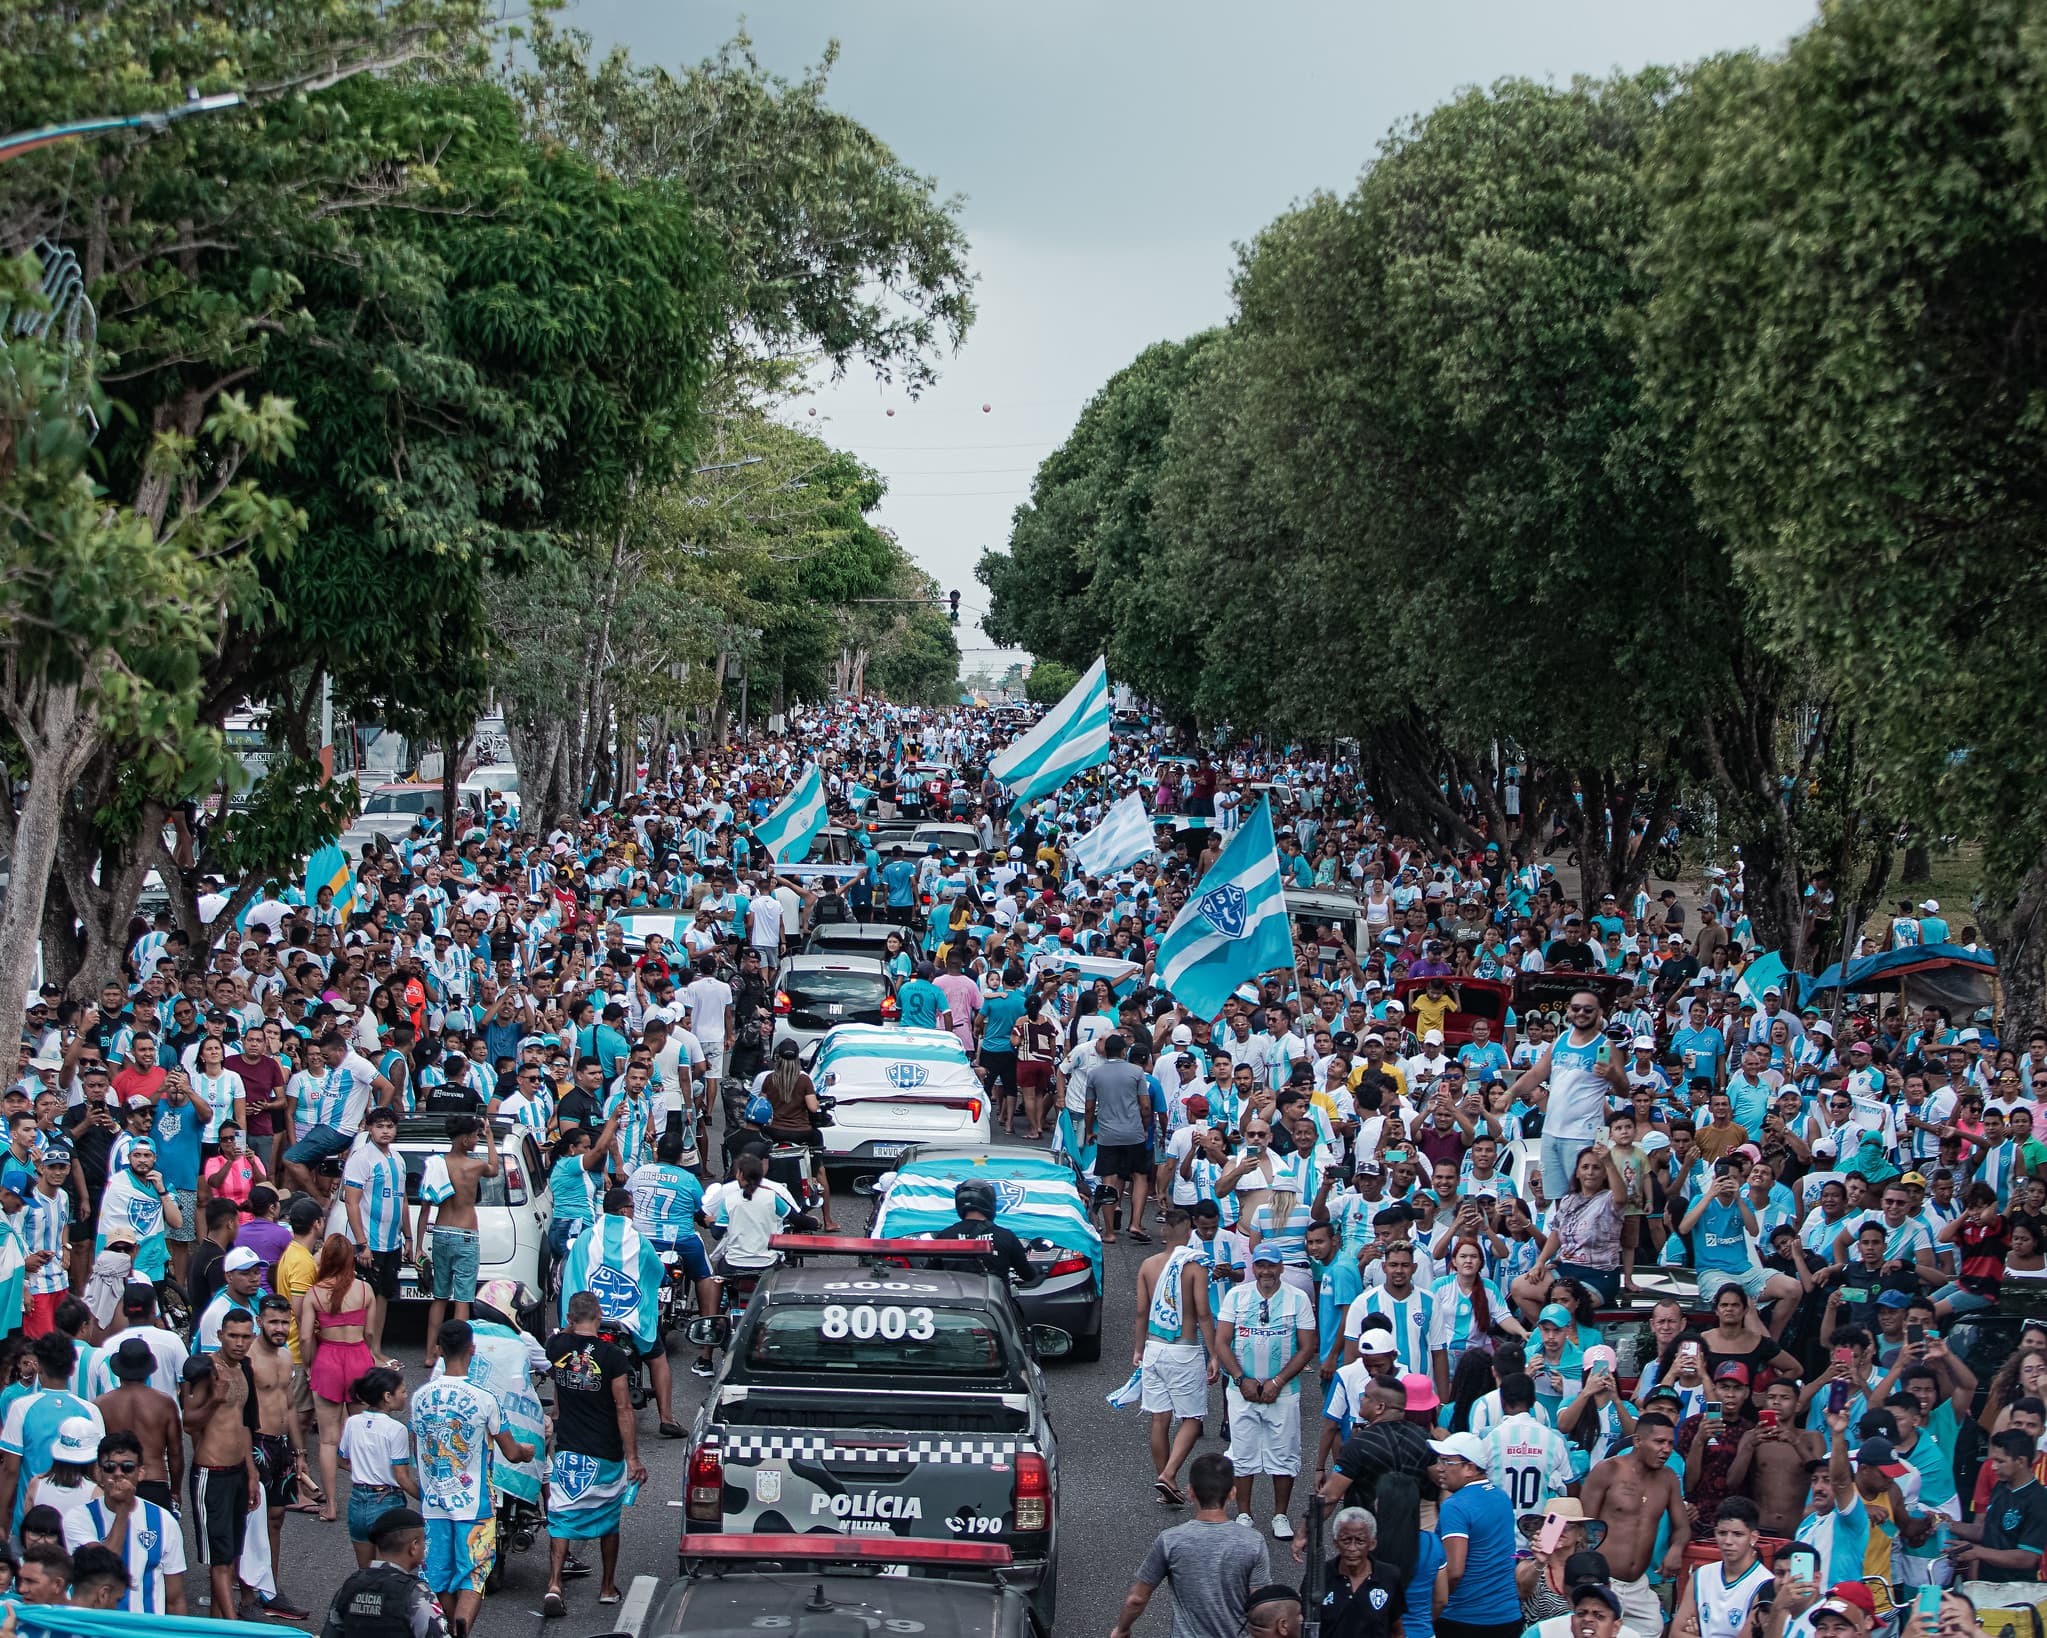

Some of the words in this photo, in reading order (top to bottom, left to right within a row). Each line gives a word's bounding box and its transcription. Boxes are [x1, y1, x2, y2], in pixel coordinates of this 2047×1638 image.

[829, 1004, 843, 1015] FIAT
[910, 993, 924, 1015] 9
[639, 1172, 678, 1184] AUGUSTO
[637, 1186, 677, 1220] 77
[823, 1281, 939, 1292] 8003
[822, 1305, 935, 1340] 8003
[1505, 1466, 1541, 1510] 10
[810, 1490, 922, 1519] POLÍCIA
[839, 1520, 890, 1532] MILITAR
[967, 1517, 1003, 1534] 190
[350, 1603, 381, 1616] MILITAR
